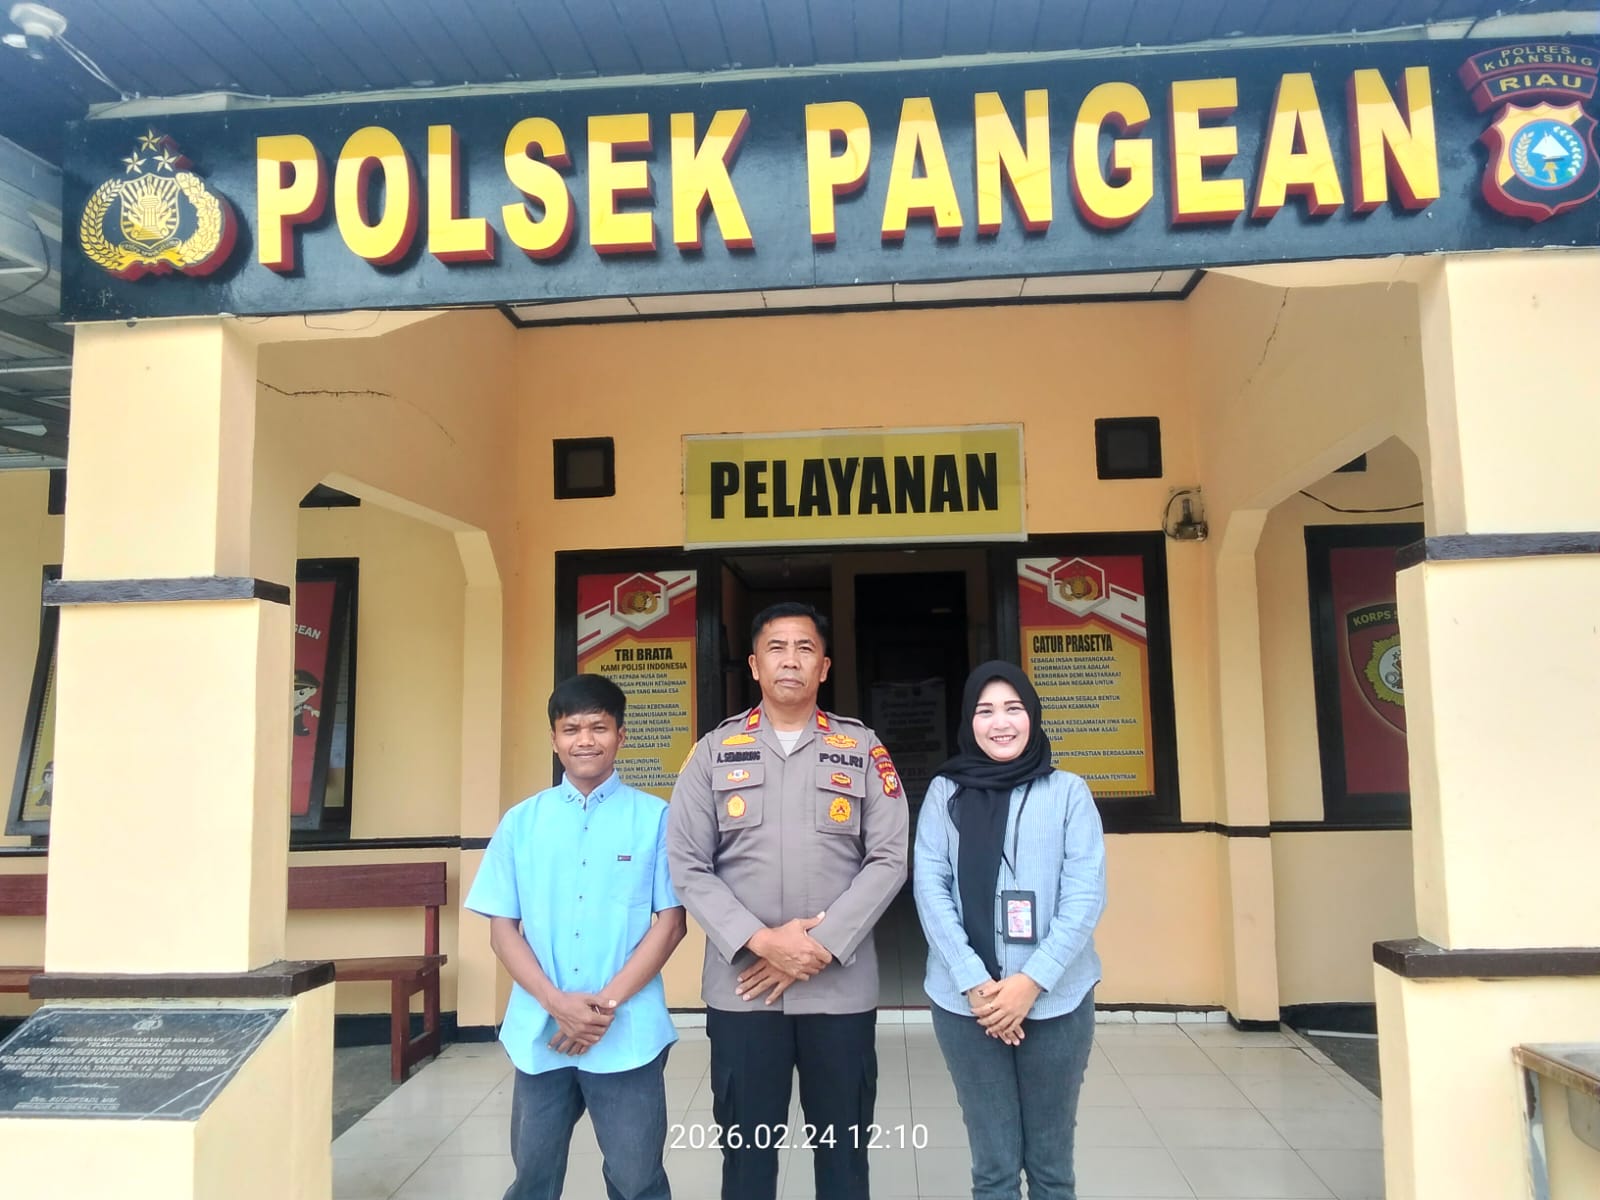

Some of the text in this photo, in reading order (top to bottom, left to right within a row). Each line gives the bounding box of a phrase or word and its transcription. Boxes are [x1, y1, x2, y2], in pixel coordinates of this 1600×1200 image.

[1501, 46, 1571, 58] POLRES
[1484, 54, 1593, 71] KUANSING
[1499, 74, 1582, 92] RIAU
[257, 66, 1440, 268] POLSEK PANGEAN
[710, 452, 999, 519] PELAYANAN
[1352, 610, 1392, 626] KORPS
[1033, 634, 1113, 654] CATUR PRASETYA
[614, 648, 672, 662] TRI BRATA
[600, 662, 687, 672] KAMI POLISI INDONESIA
[819, 752, 863, 768] POLRI
[129, 1056, 180, 1064] KUANTAN
